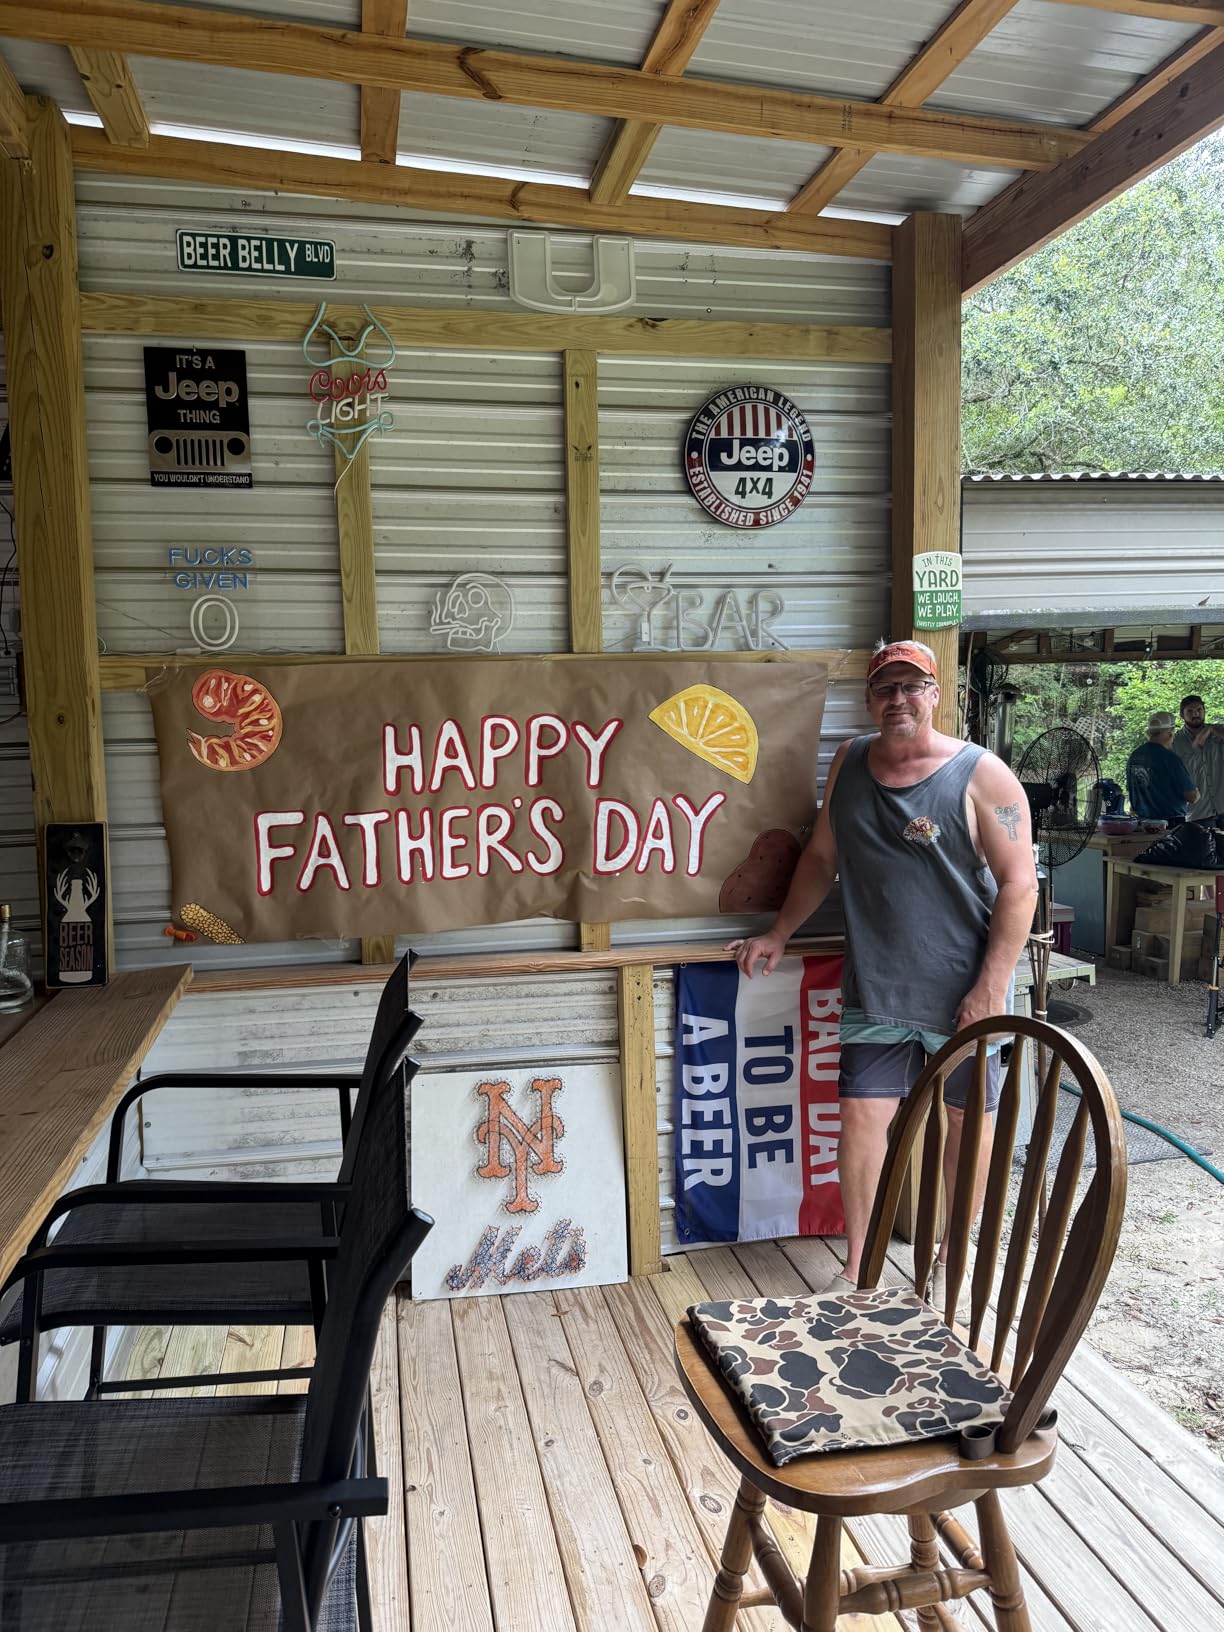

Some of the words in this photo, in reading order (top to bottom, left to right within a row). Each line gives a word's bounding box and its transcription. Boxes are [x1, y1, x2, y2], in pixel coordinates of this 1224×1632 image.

[182, 235, 232, 268] BEER
[237, 238, 298, 272] BELLY
[305, 243, 331, 263] BLVD
[175, 354, 202, 369] IT'S
[204, 356, 216, 369] A
[154, 371, 240, 408] Jeep
[309, 367, 388, 404] Coors
[176, 409, 221, 424] THING
[316, 393, 390, 424] LIGHT
[691, 413, 713, 440] THE
[711, 386, 775, 416] AMERICAN
[777, 396, 813, 443] LEGEND
[720, 438, 790, 472] Jeep
[153, 473, 169, 483] YOU
[169, 474, 205, 484] WOULDN'T
[205, 475, 250, 485] UNDERSTAND
[734, 476, 774, 500] 4X4
[689, 467, 754, 526] ESTABLISHED
[758, 497, 796, 526] SINCE
[792, 467, 813, 501] 1941
[168, 546, 254, 567] FUCKS
[921, 556, 932, 567] IN
[934, 555, 953, 567] THIS
[174, 572, 249, 591] GIVEN
[915, 569, 960, 588] YARD
[917, 592, 931, 604] WE
[932, 591, 960, 604] LAUGH.
[917, 605, 933, 618] WE
[935, 603, 959, 617] PLAY.
[676, 589, 790, 652] BAR
[382, 713, 625, 796] HAPPY
[253, 796, 565, 895] FATHER'S
[594, 791, 727, 877] DAY
[59, 923, 93, 946] BEER
[59, 945, 94, 971] SEASON
[682, 1013, 729, 1046] A
[742, 1025, 794, 1085] TO
[681, 1062, 733, 1191] BEER
[744, 1105, 794, 1169] BE
[446, 1218, 587, 1291] Mets
